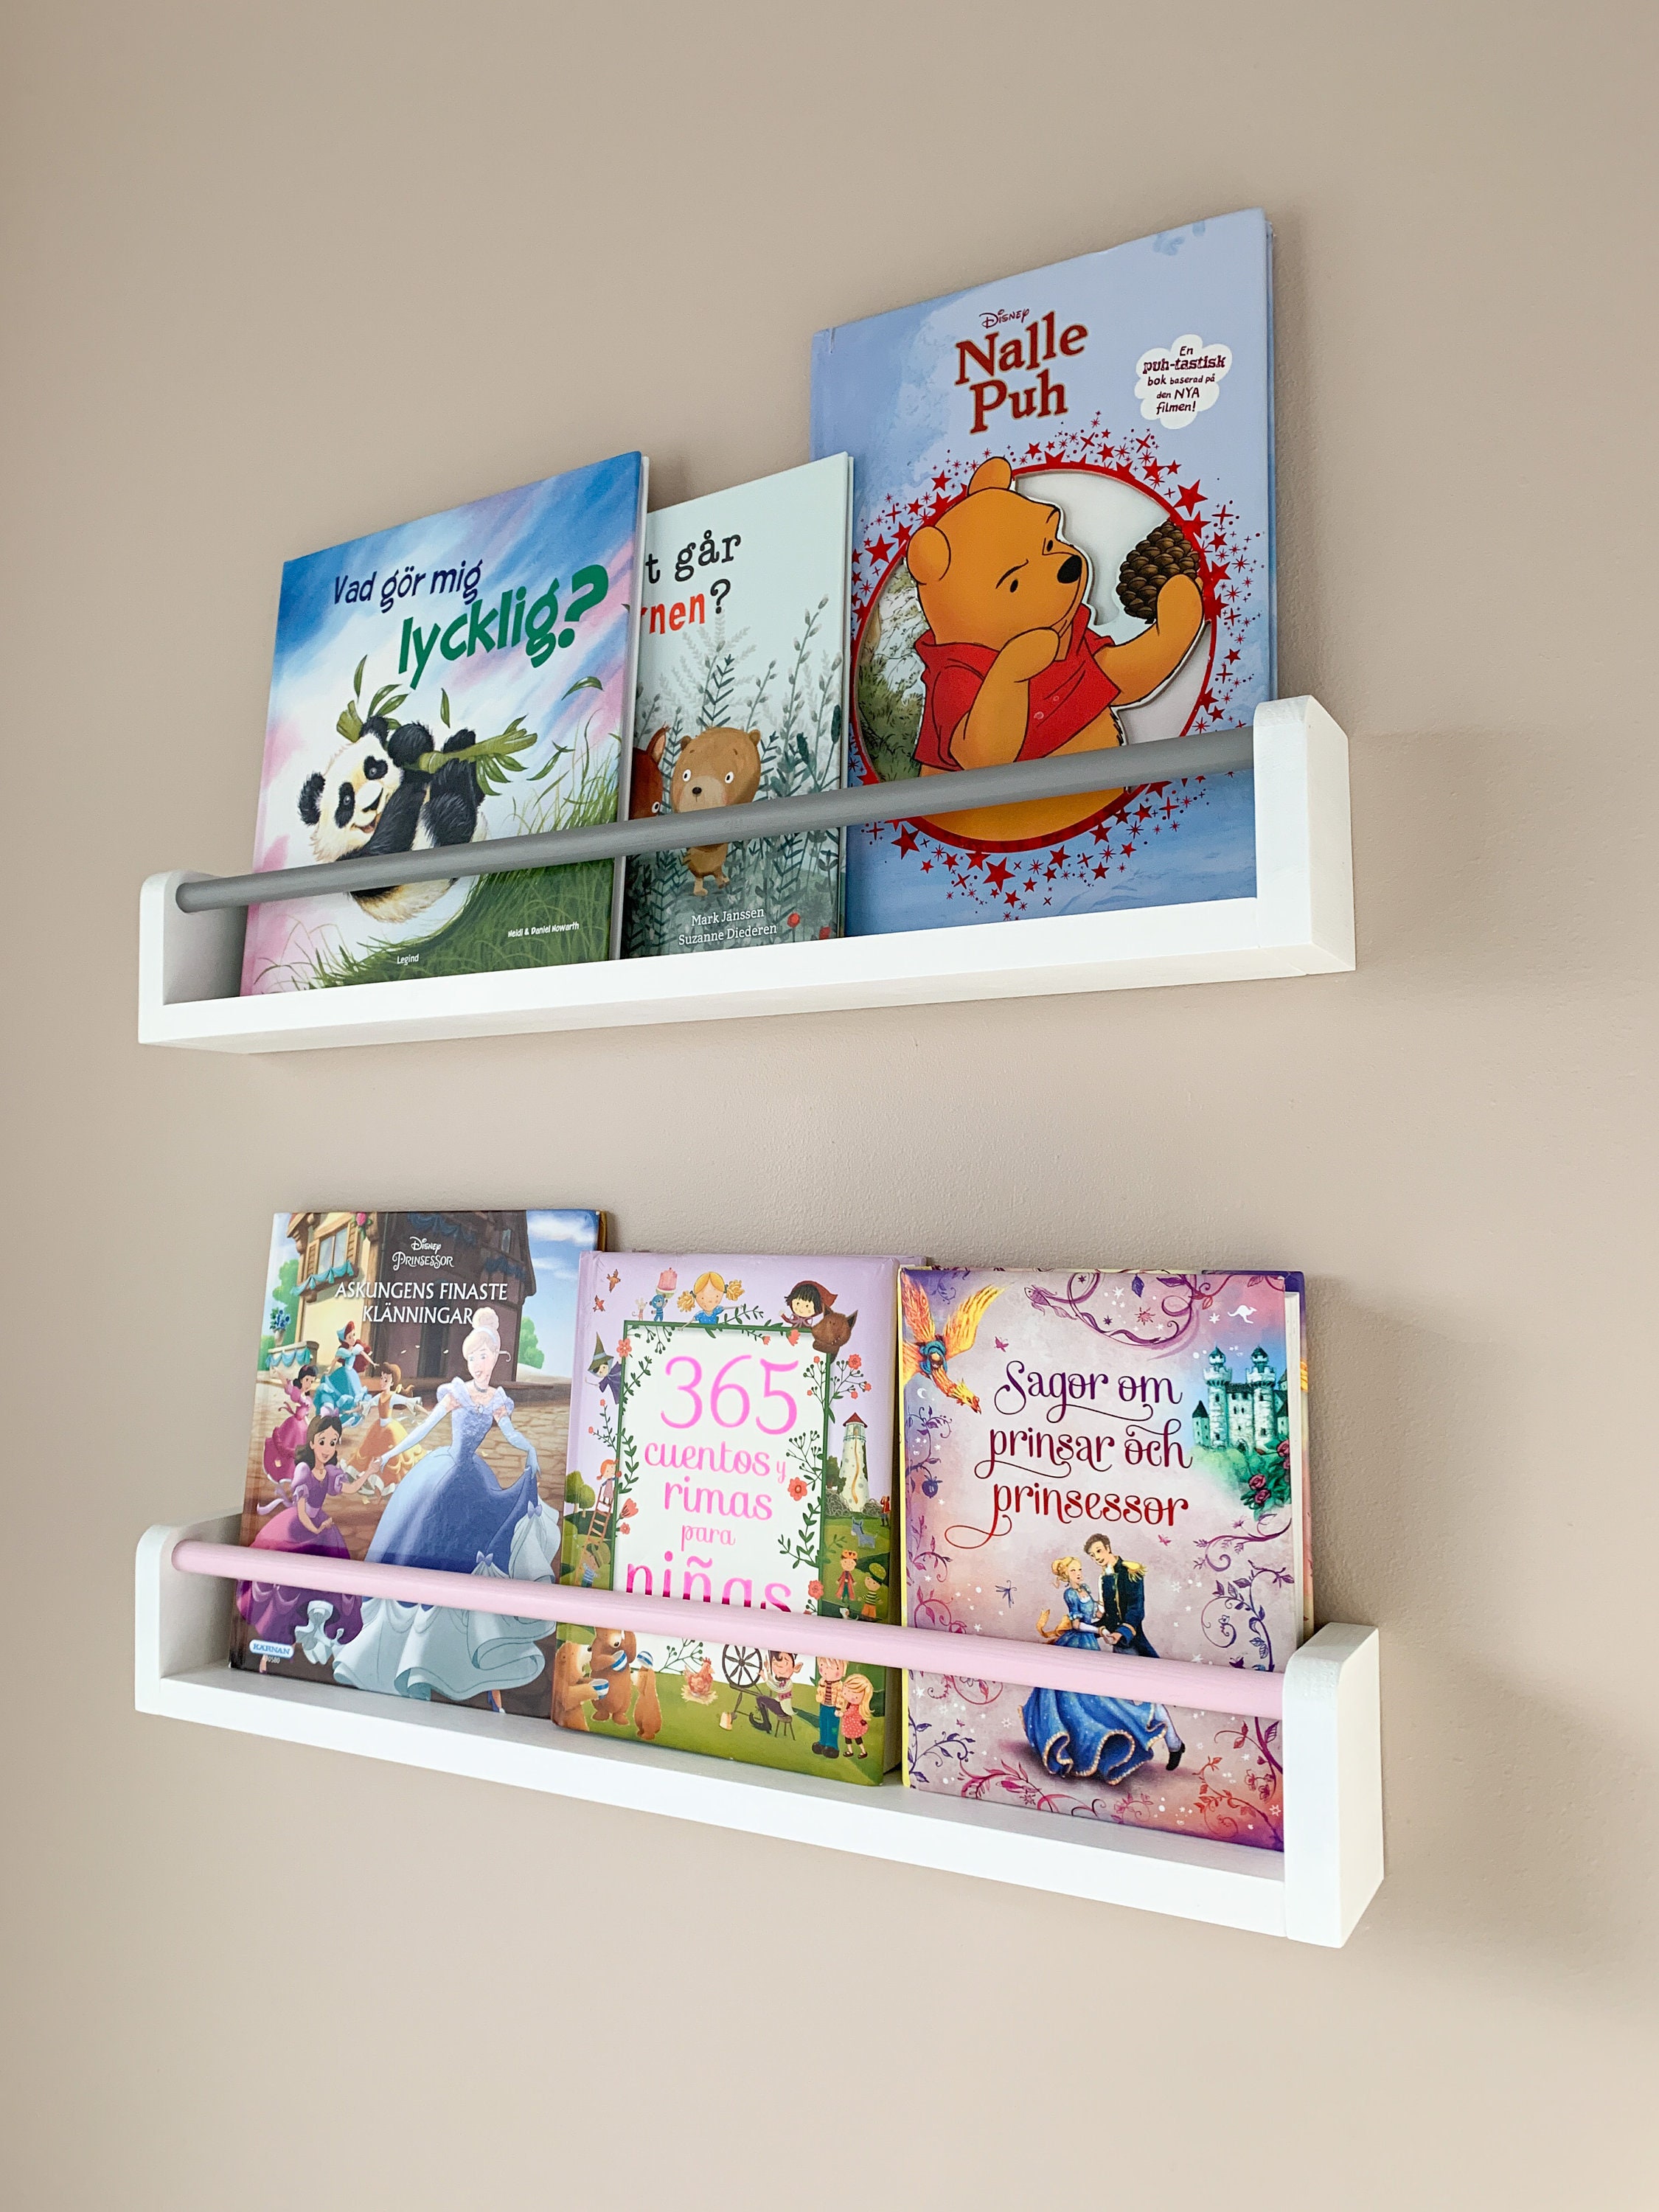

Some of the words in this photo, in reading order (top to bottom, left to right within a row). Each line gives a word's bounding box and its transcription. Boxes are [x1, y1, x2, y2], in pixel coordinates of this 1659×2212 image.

[954, 310, 1089, 386] Nalle
[1180, 346, 1194, 356] En
[1142, 355, 1226, 375] puh-tastisk
[1147, 375, 1166, 386] bok
[1169, 375, 1203, 385] baserad
[1205, 373, 1215, 383] på
[1156, 391, 1171, 399] den
[1174, 386, 1200, 400] NYA
[970, 368, 1068, 435] Puh
[1156, 400, 1197, 415] filmen!
[674, 529, 742, 582] går
[334, 571, 378, 605] Vad
[380, 566, 427, 613] gör
[430, 559, 484, 605] mig
[398, 564, 609, 690] lycklig?
[507, 928, 524, 938] Heidi
[524, 928, 529, 936] &
[530, 925, 552, 935] Daniel
[551, 921, 580, 933] Howarth
[691, 912, 720, 927] Mark
[720, 908, 765, 922] Janssen
[678, 931, 725, 946] Suzanne
[726, 924, 777, 940] Diederen
[396, 953, 420, 966] Legind
[334, 1281, 435, 1300] ASKUNGENS
[439, 1282, 508, 1301] FINASTE
[362, 1301, 473, 1325] KLÄNNINGAR
[660, 1354, 799, 1436] 365
[994, 1360, 1153, 1424] Sagor
[1118, 1375, 1183, 1405] om
[644, 1440, 771, 1477] cuentos
[776, 1460, 787, 1484] y
[974, 1427, 1116, 1480] prinsar
[1124, 1418, 1194, 1470] och
[664, 1475, 773, 1521] rimas
[944, 1482, 1189, 1550] prinsessor
[681, 1524, 736, 1552] para
